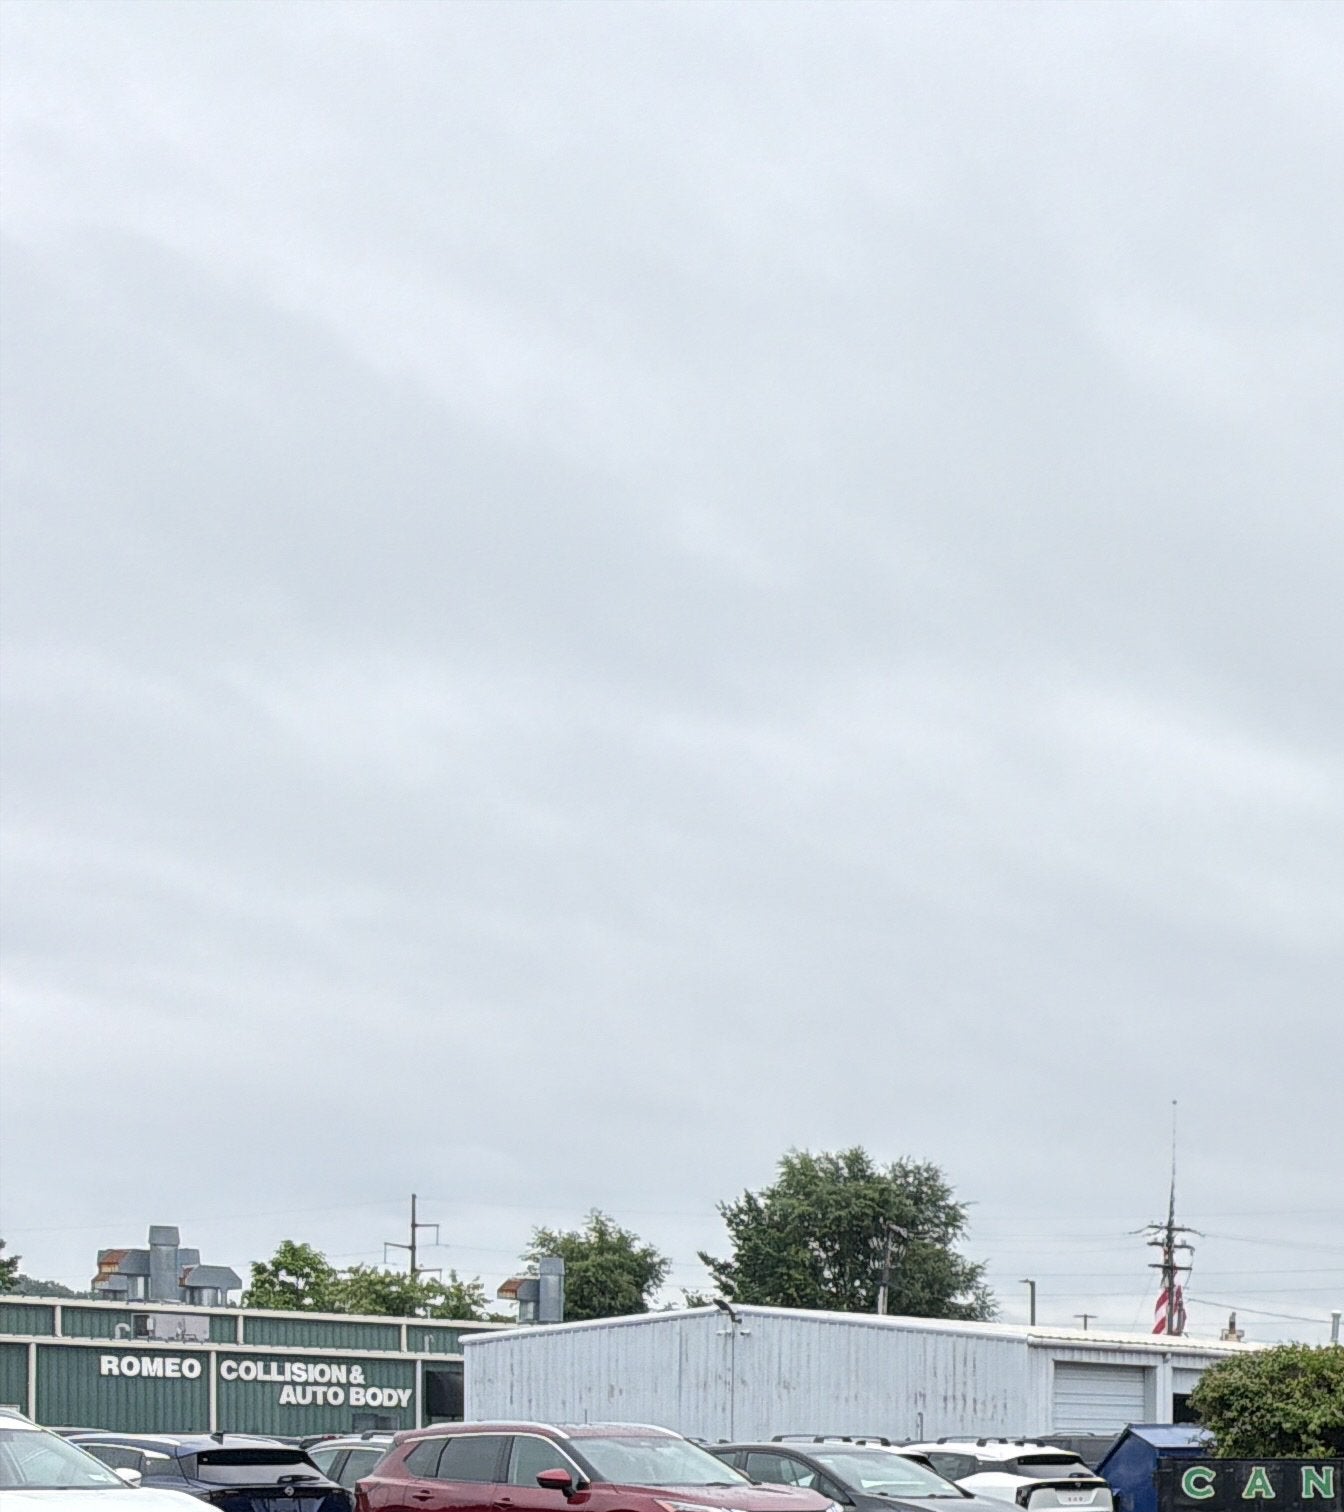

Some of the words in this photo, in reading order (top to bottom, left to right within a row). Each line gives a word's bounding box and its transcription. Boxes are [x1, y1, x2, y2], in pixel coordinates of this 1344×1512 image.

[100, 1355, 201, 1378] ROMEO
[220, 1360, 347, 1384] COLLISION
[349, 1365, 365, 1385] &
[279, 1385, 345, 1406] AUTO
[350, 1387, 412, 1407] BODY
